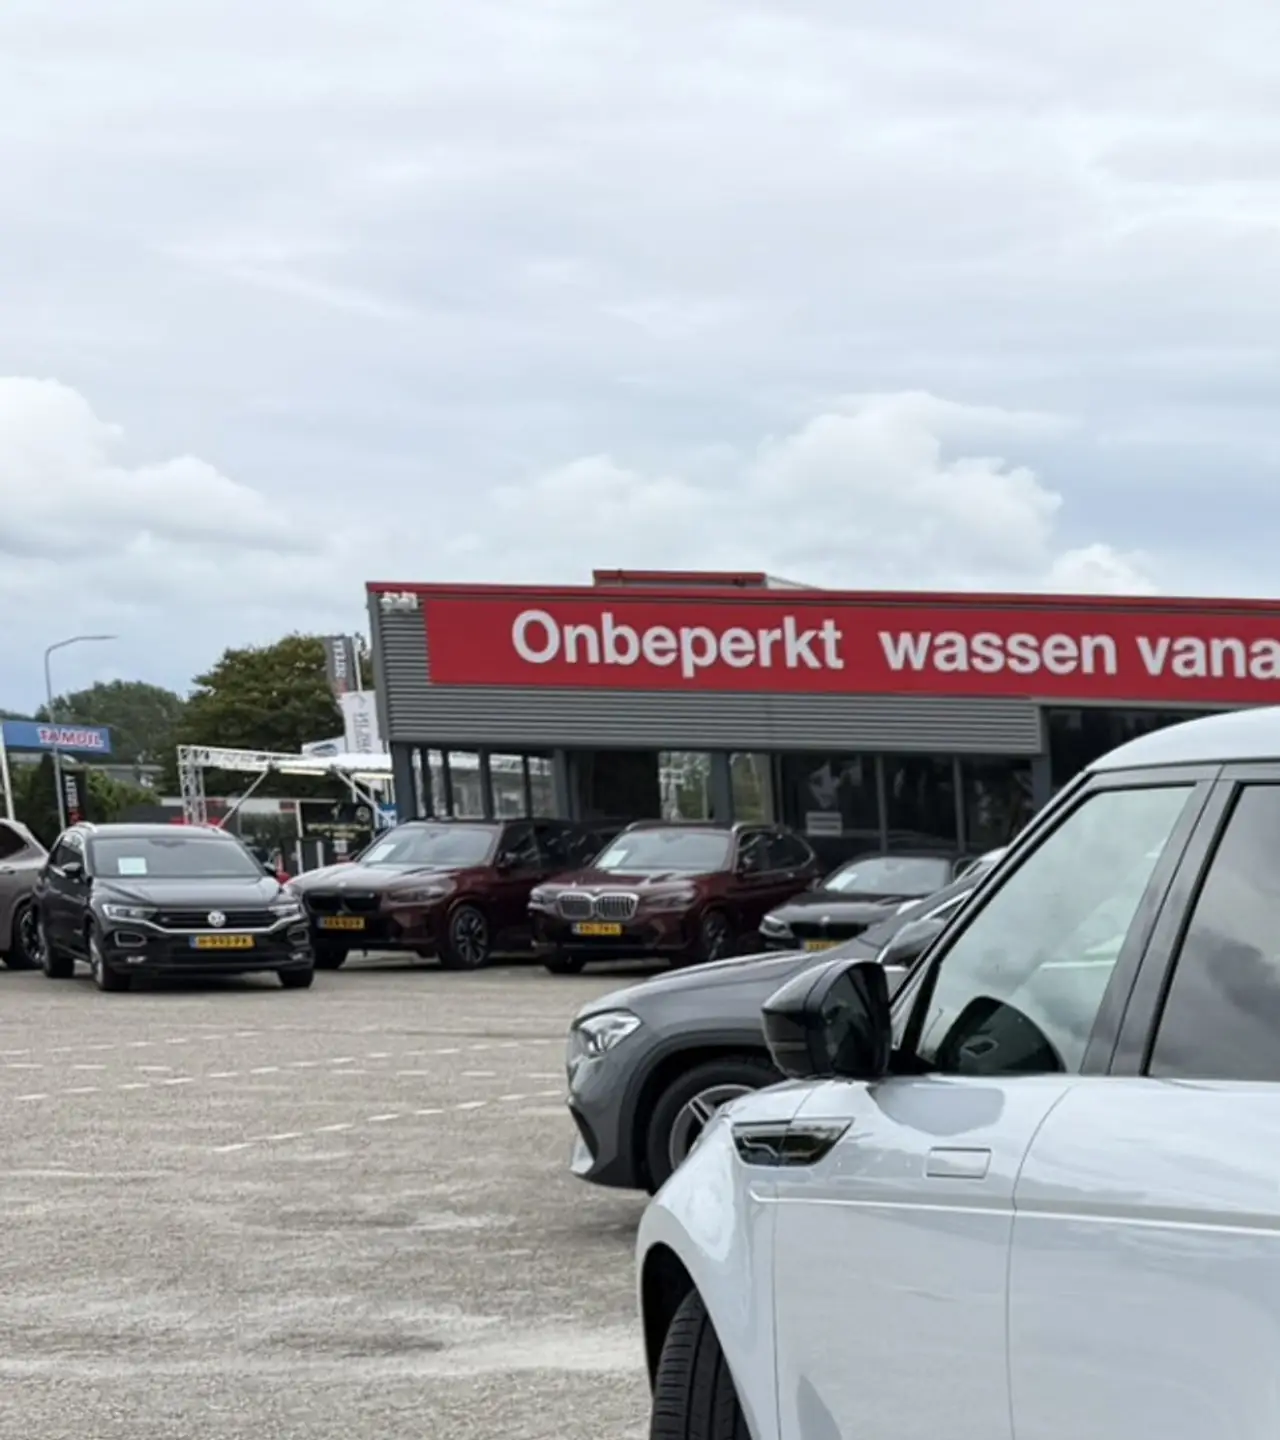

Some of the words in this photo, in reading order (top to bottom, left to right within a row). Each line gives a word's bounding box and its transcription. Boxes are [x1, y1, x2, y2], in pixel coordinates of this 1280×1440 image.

[512, 609, 844, 679] Onbeperkt
[878, 630, 1117, 675] wassen
[37, 727, 104, 747] TAMOIL
